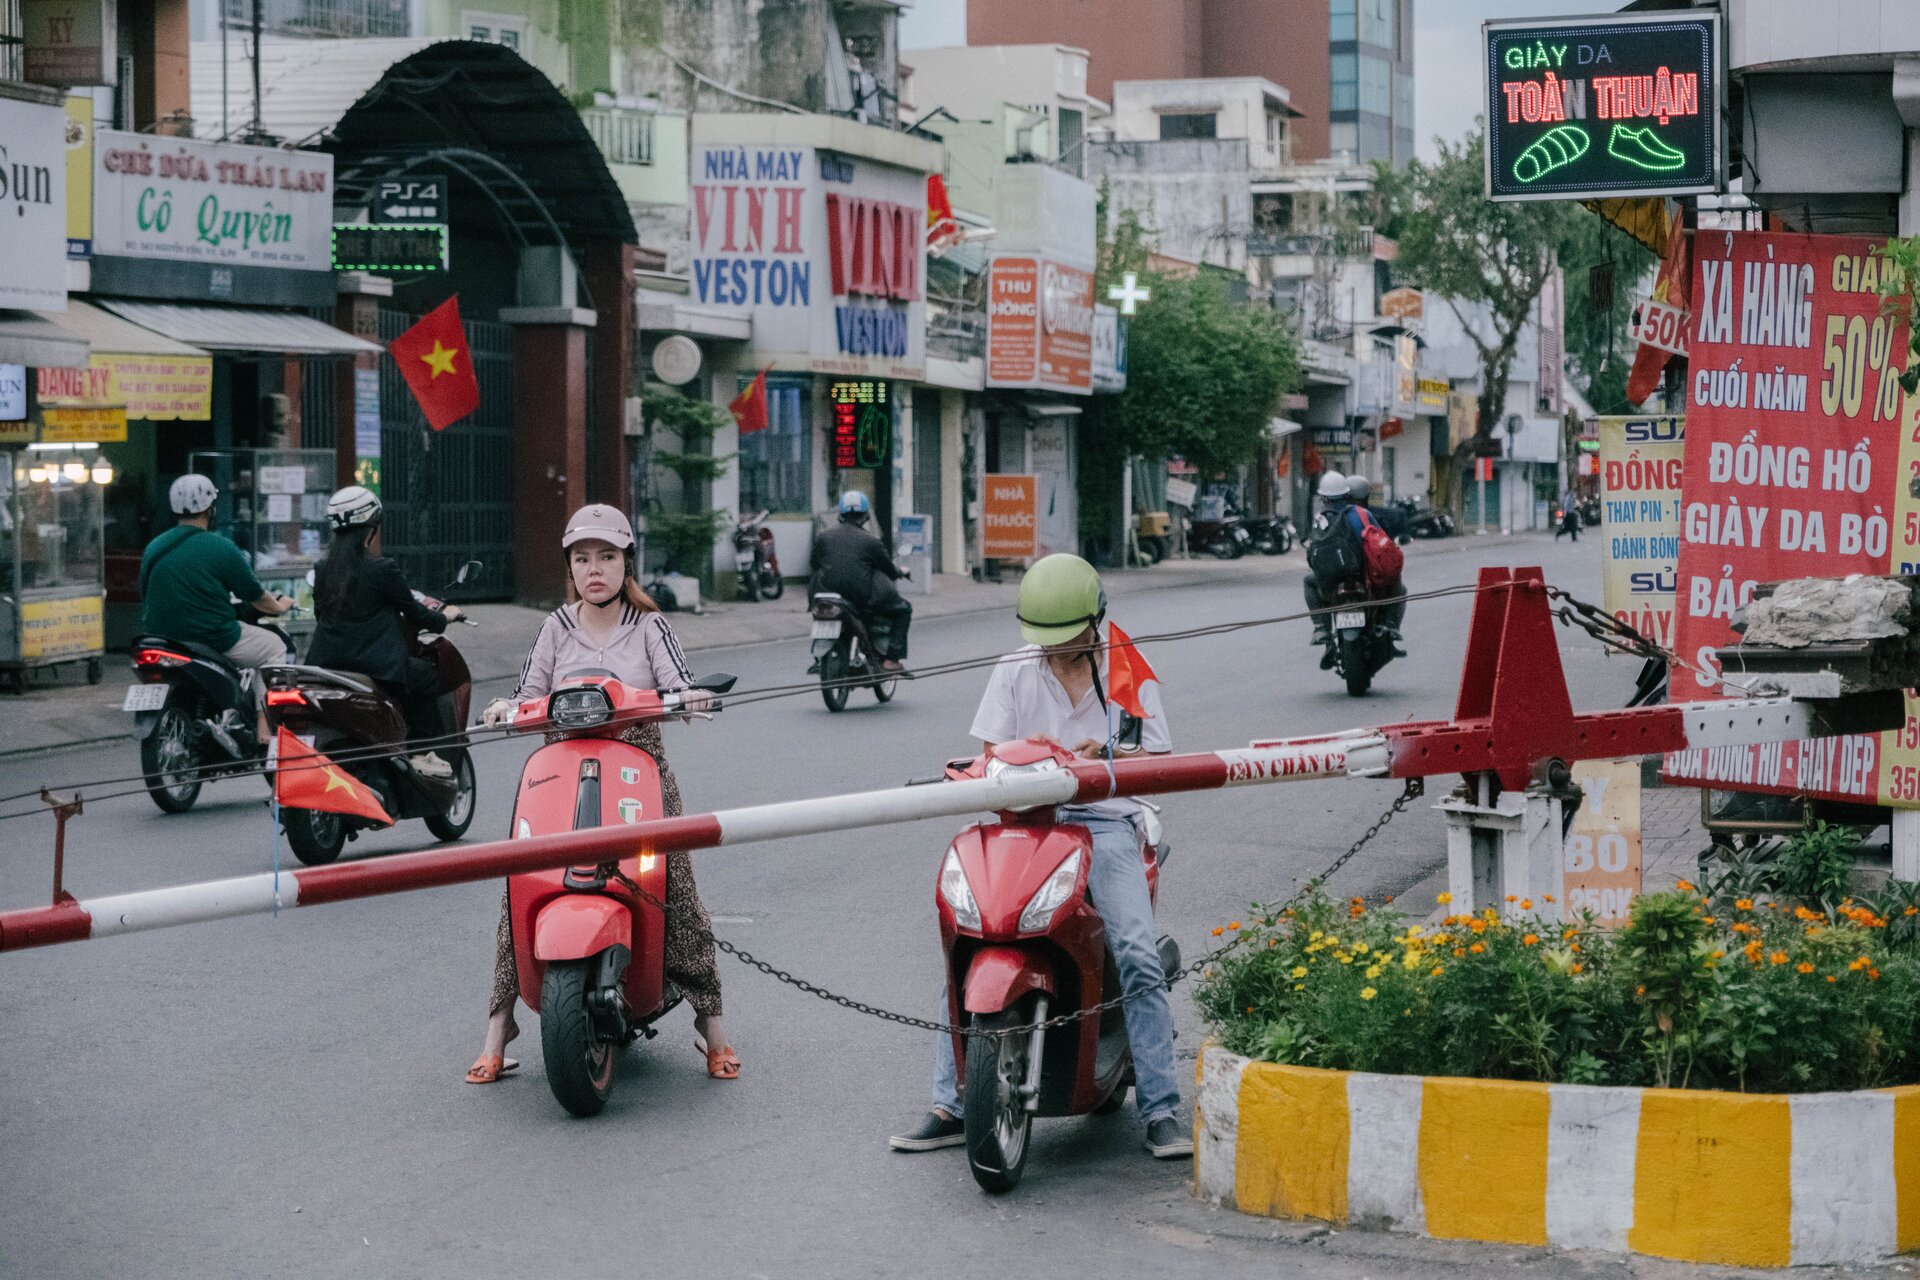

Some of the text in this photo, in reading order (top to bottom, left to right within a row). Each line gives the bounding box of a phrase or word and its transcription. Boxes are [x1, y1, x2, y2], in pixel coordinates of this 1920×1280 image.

[1505, 41, 1612, 69] GIÀY DA
[1503, 66, 1698, 125] TOÀN THUẬN
[104, 142, 152, 176] CHÈ
[216, 157, 275, 189] THÁI
[280, 169, 327, 192] LAN
[705, 147, 803, 180] NHÀ MAY
[381, 183, 439, 199] PS4
[137, 187, 292, 249] Cô Quyên
[693, 186, 806, 253] VINH
[826, 192, 922, 301] VINH
[694, 259, 810, 306] VESTON
[998, 279, 1032, 294] THU
[1698, 231, 1906, 348] XẢ HÀNG GIẢM
[836, 305, 908, 357] VESTON
[1695, 358, 1808, 412] CUỐI NĂM
[1820, 314, 1901, 422] 50%
[1605, 449, 1683, 491] ĐỒNG
[1709, 429, 1871, 493] ĐỒNG HỒ
[993, 485, 1026, 501] NHÀ
[1606, 501, 1637, 523] THAY
[1640, 501, 1662, 522] PIN
[1612, 532, 1647, 559] ĐÁNH
[1685, 496, 1888, 558] GIÀY DA BÒ
[1896, 716, 1920, 750] 15
[1324, 753, 1346, 772] C2
[1889, 765, 1920, 801] 35
[1565, 824, 1629, 873] BÒ
